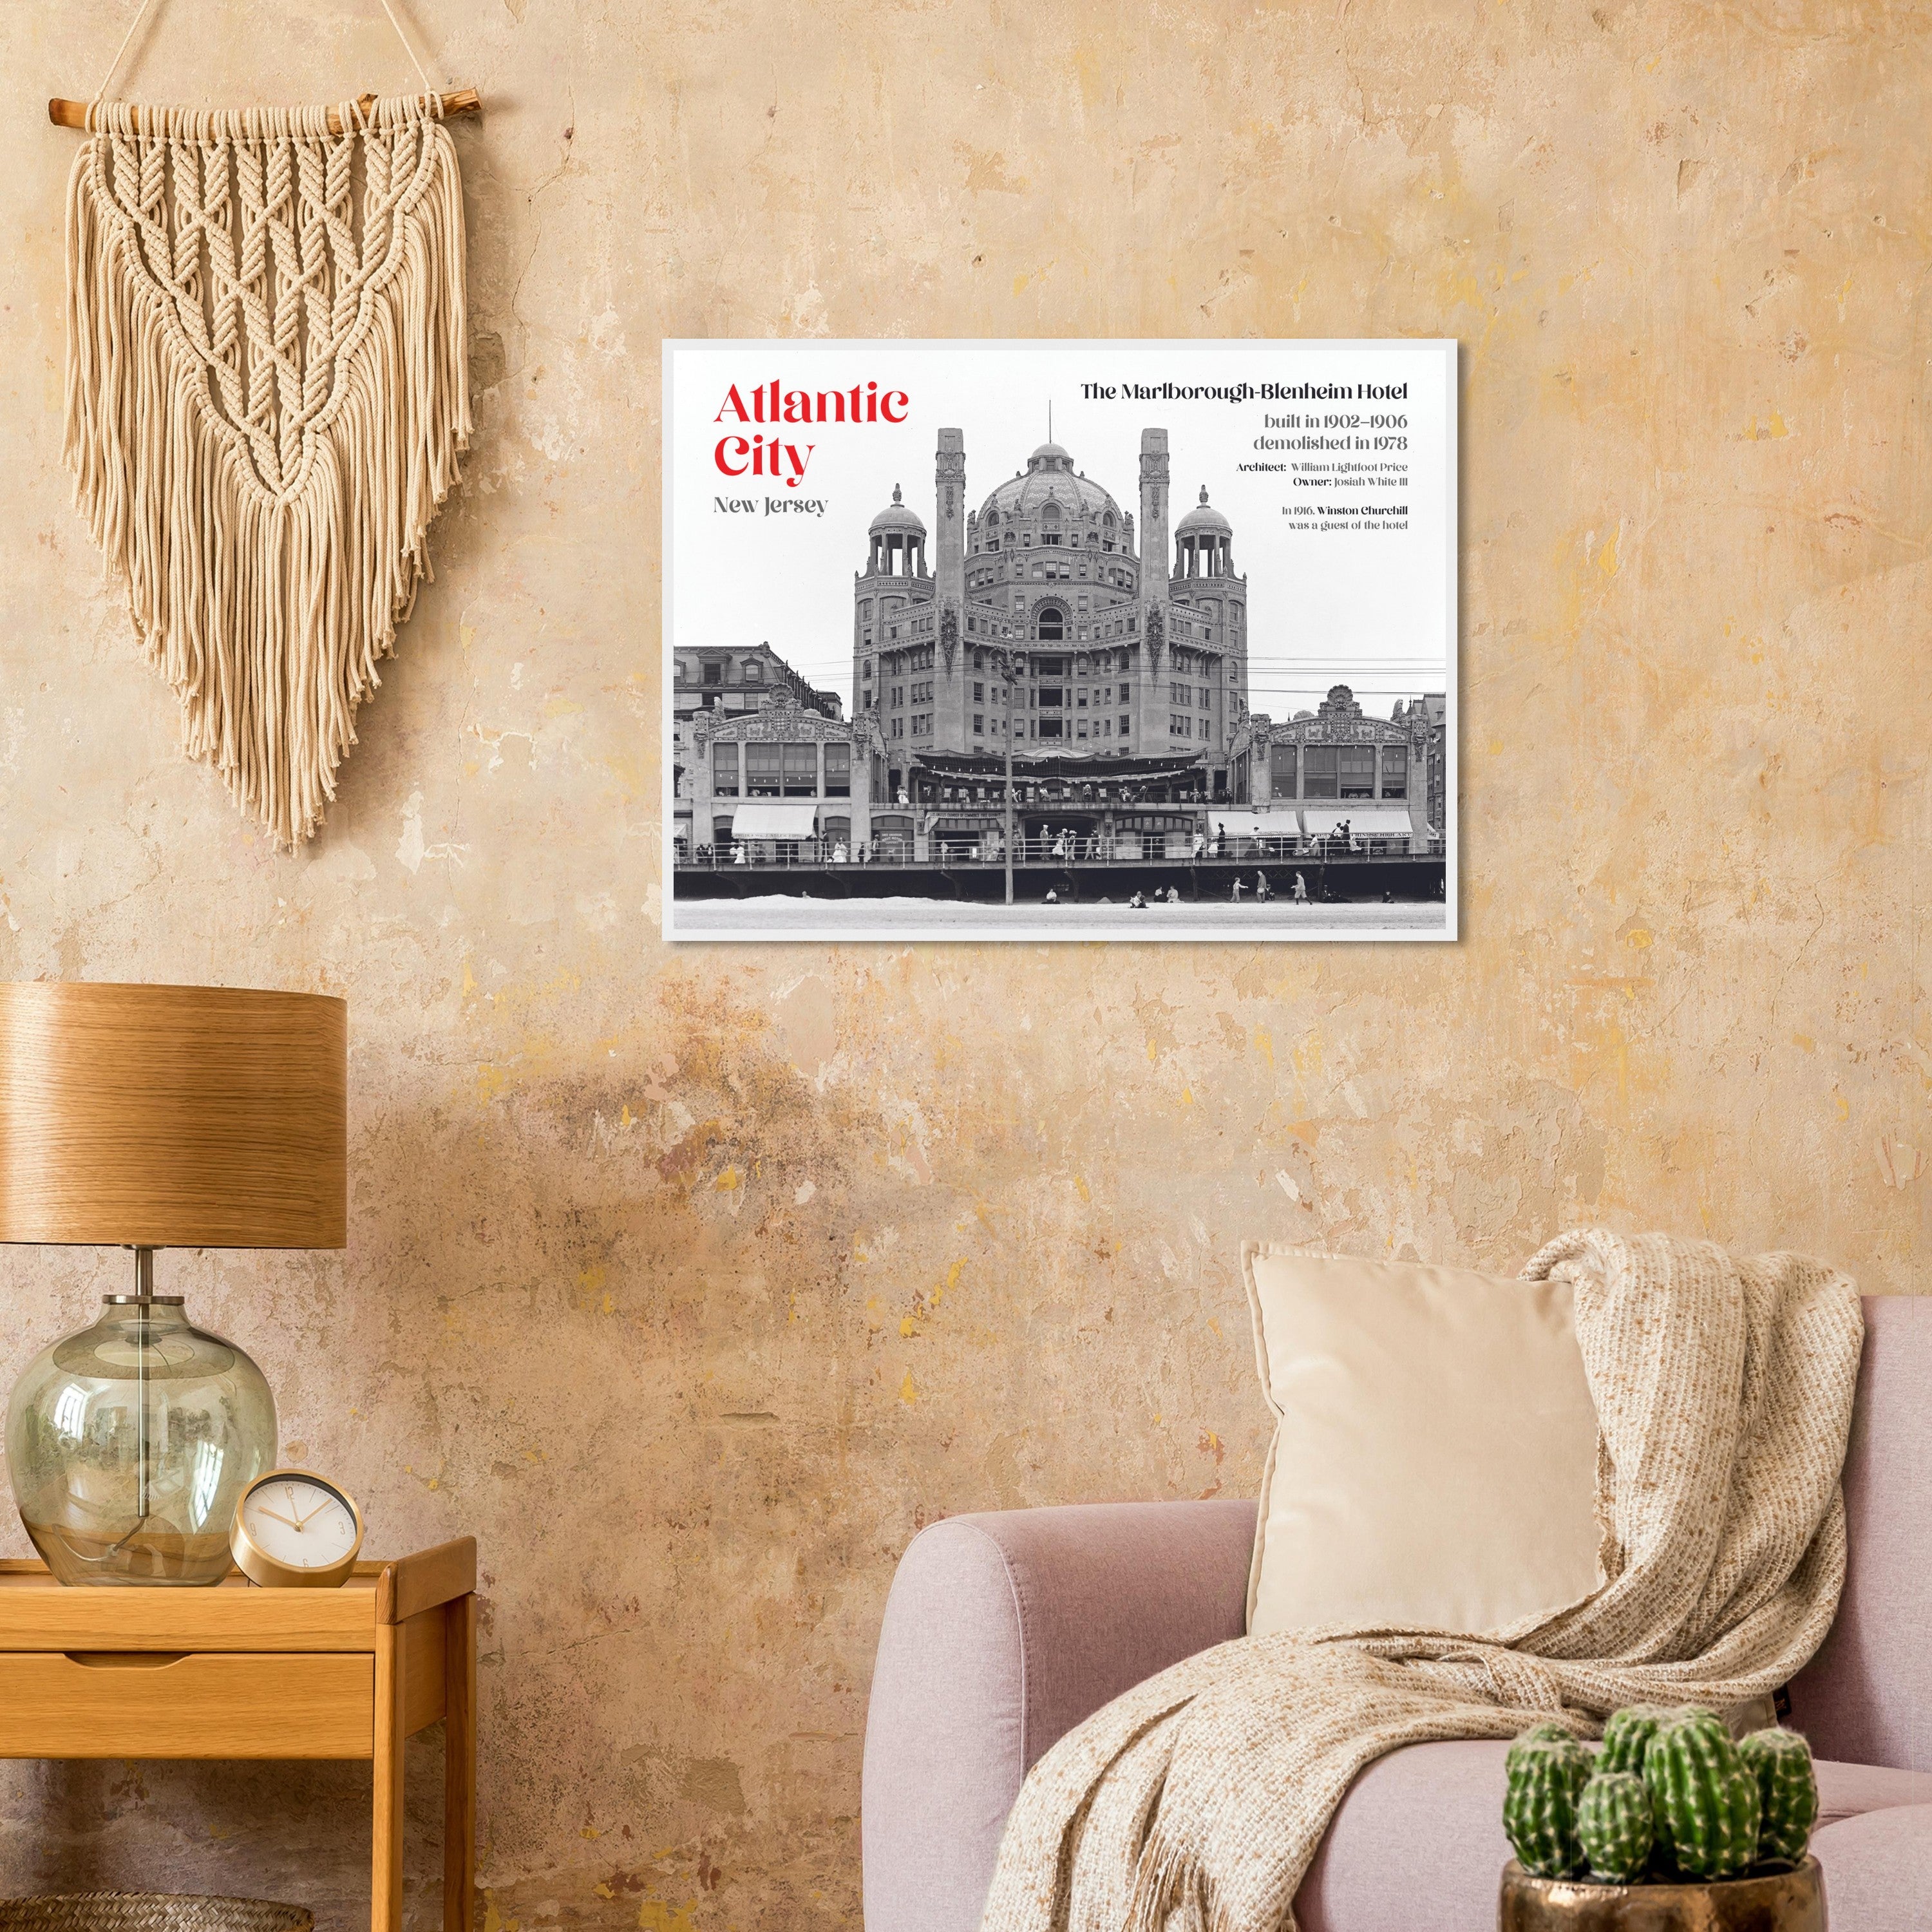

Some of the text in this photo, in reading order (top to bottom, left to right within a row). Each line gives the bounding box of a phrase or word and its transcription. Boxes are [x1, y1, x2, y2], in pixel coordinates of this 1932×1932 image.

[1081, 383, 1407, 403] The Marlborough-Blenheim Hotel
[714, 379, 909, 423] Atlantic
[1265, 414, 1300, 428] built
[1305, 415, 1320, 428] in
[1254, 435, 1407, 450] demolished in 1978
[715, 435, 815, 488] City
[1236, 462, 1408, 473] Architect: William Lightfoot Price
[1293, 478, 1331, 486] Owner:
[1334, 477, 1365, 488] Josiah
[1368, 477, 1397, 486] White
[714, 497, 828, 517] New Jersey
[1317, 506, 1358, 515] Winston
[1361, 506, 1408, 515] Churchill
[1321, 521, 1348, 531] guest
[1351, 521, 1361, 529] of
[1365, 520, 1380, 529] the
[1383, 520, 1408, 529] hotel
[285, 1486, 295, 1500] 12
[250, 1522, 257, 1537] 9
[338, 1521, 345, 1535] 3
[303, 1558, 310, 1567] 6
